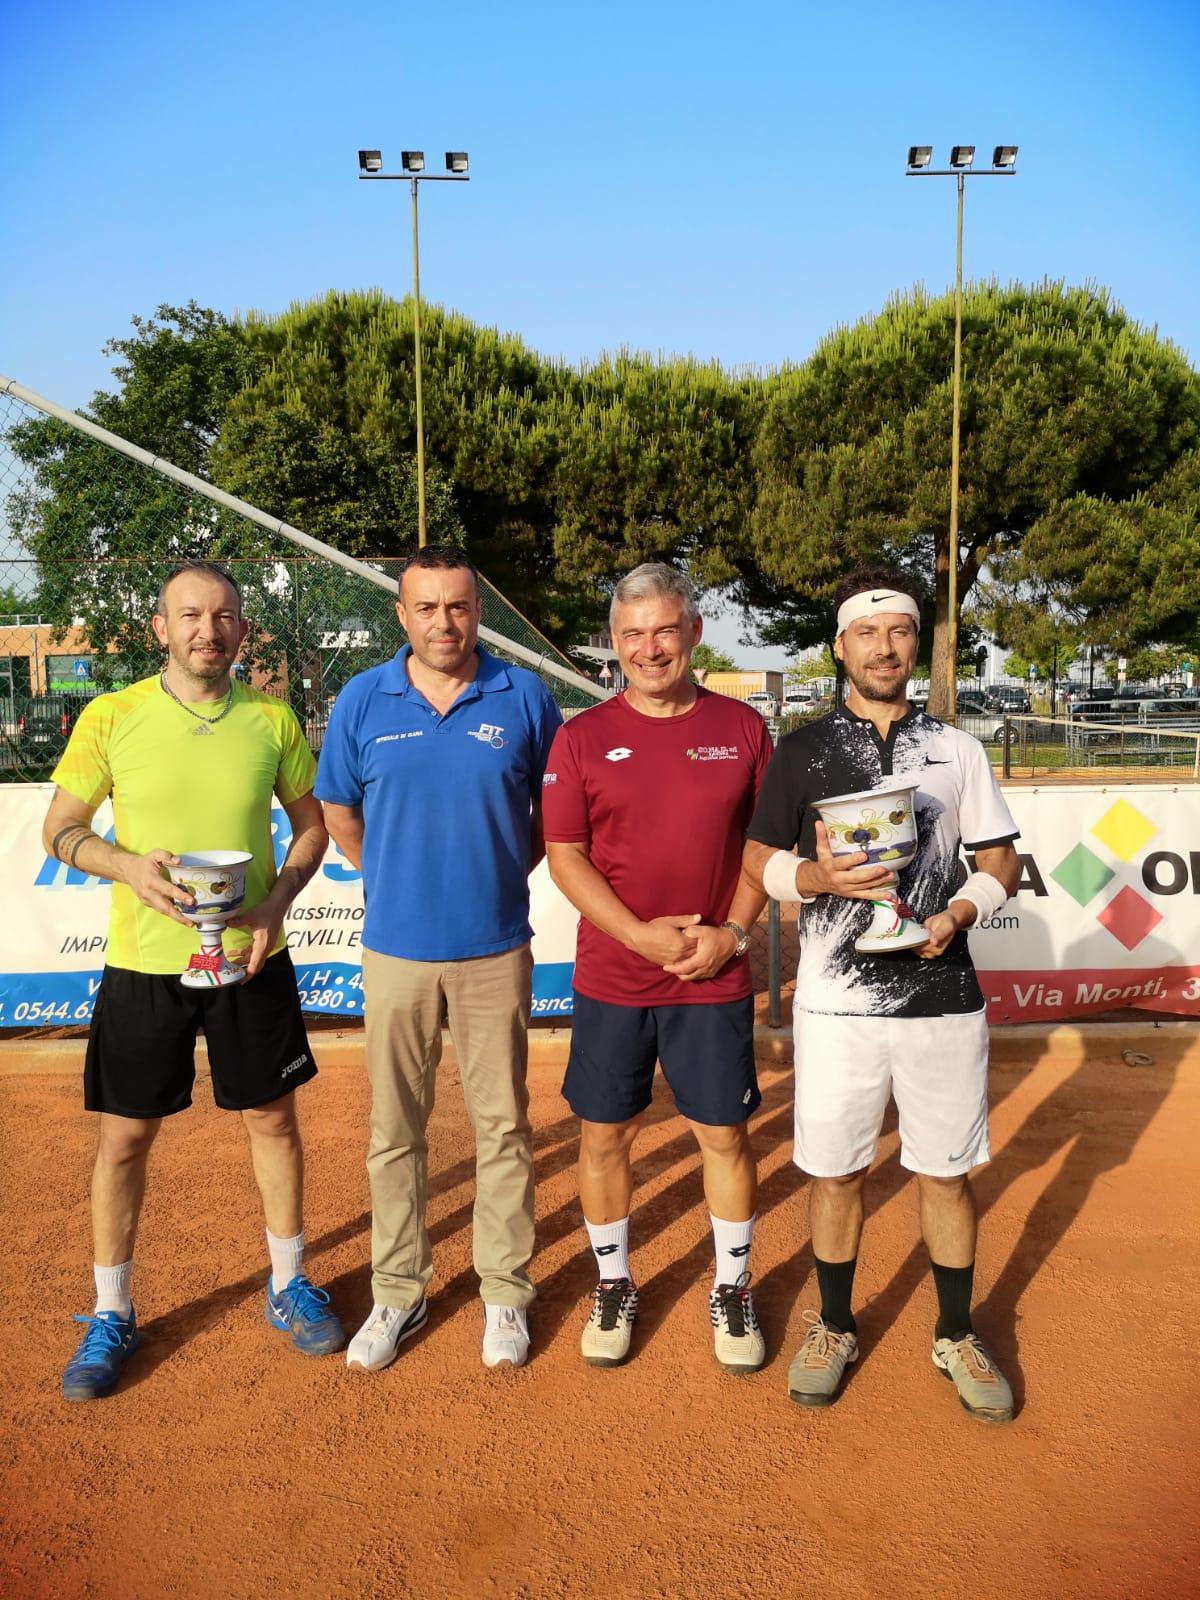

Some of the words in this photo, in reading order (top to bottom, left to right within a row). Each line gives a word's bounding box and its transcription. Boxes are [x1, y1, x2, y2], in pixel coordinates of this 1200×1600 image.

[285, 901, 365, 920] assimo
[60, 936, 108, 953] IMP
[286, 929, 344, 948] CIVILI
[310, 969, 332, 987] H
[1012, 984, 1064, 1008] Via
[1074, 976, 1168, 1005] Monti,
